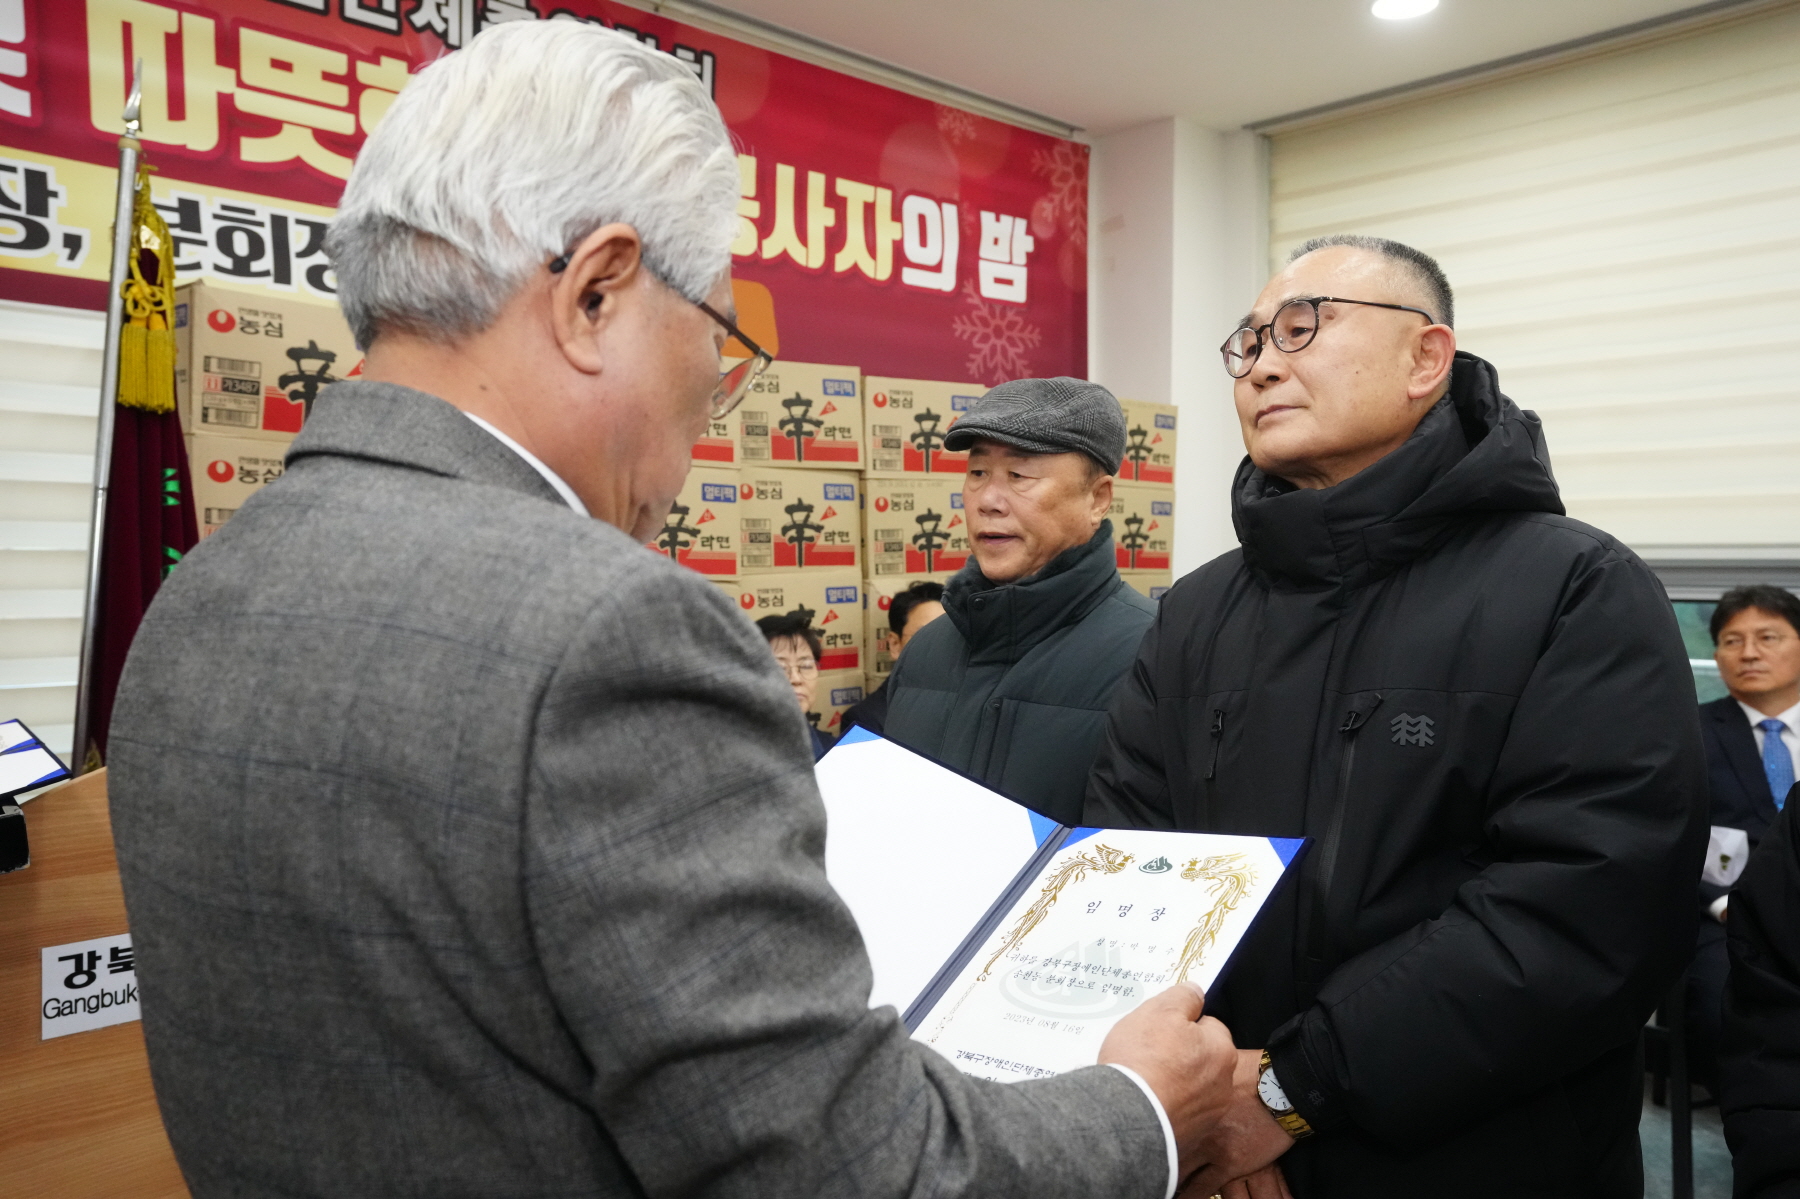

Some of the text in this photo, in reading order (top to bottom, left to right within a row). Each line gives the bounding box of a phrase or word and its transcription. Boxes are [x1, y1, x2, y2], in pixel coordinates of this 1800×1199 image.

[979, 210, 1035, 303] 밤
[239, 316, 283, 338] 농심
[889, 395, 914, 409] 농심
[779, 392, 824, 462] 辛
[824, 426, 852, 440] 라면
[911, 407, 947, 473] 辛
[756, 487, 782, 500] 농심
[890, 499, 914, 511] 농심
[781, 497, 825, 568] 辛
[824, 531, 850, 545] 라면
[701, 535, 730, 550] 라면
[912, 508, 951, 573] 辛
[1121, 512, 1150, 569] 辛
[757, 595, 784, 608] 농심
[826, 634, 853, 648] 라면
[1046, 974, 1096, 990] 분회장으로
[43, 983, 138, 1019] Gangbuk
[1003, 1012, 1036, 1026] 2023년
